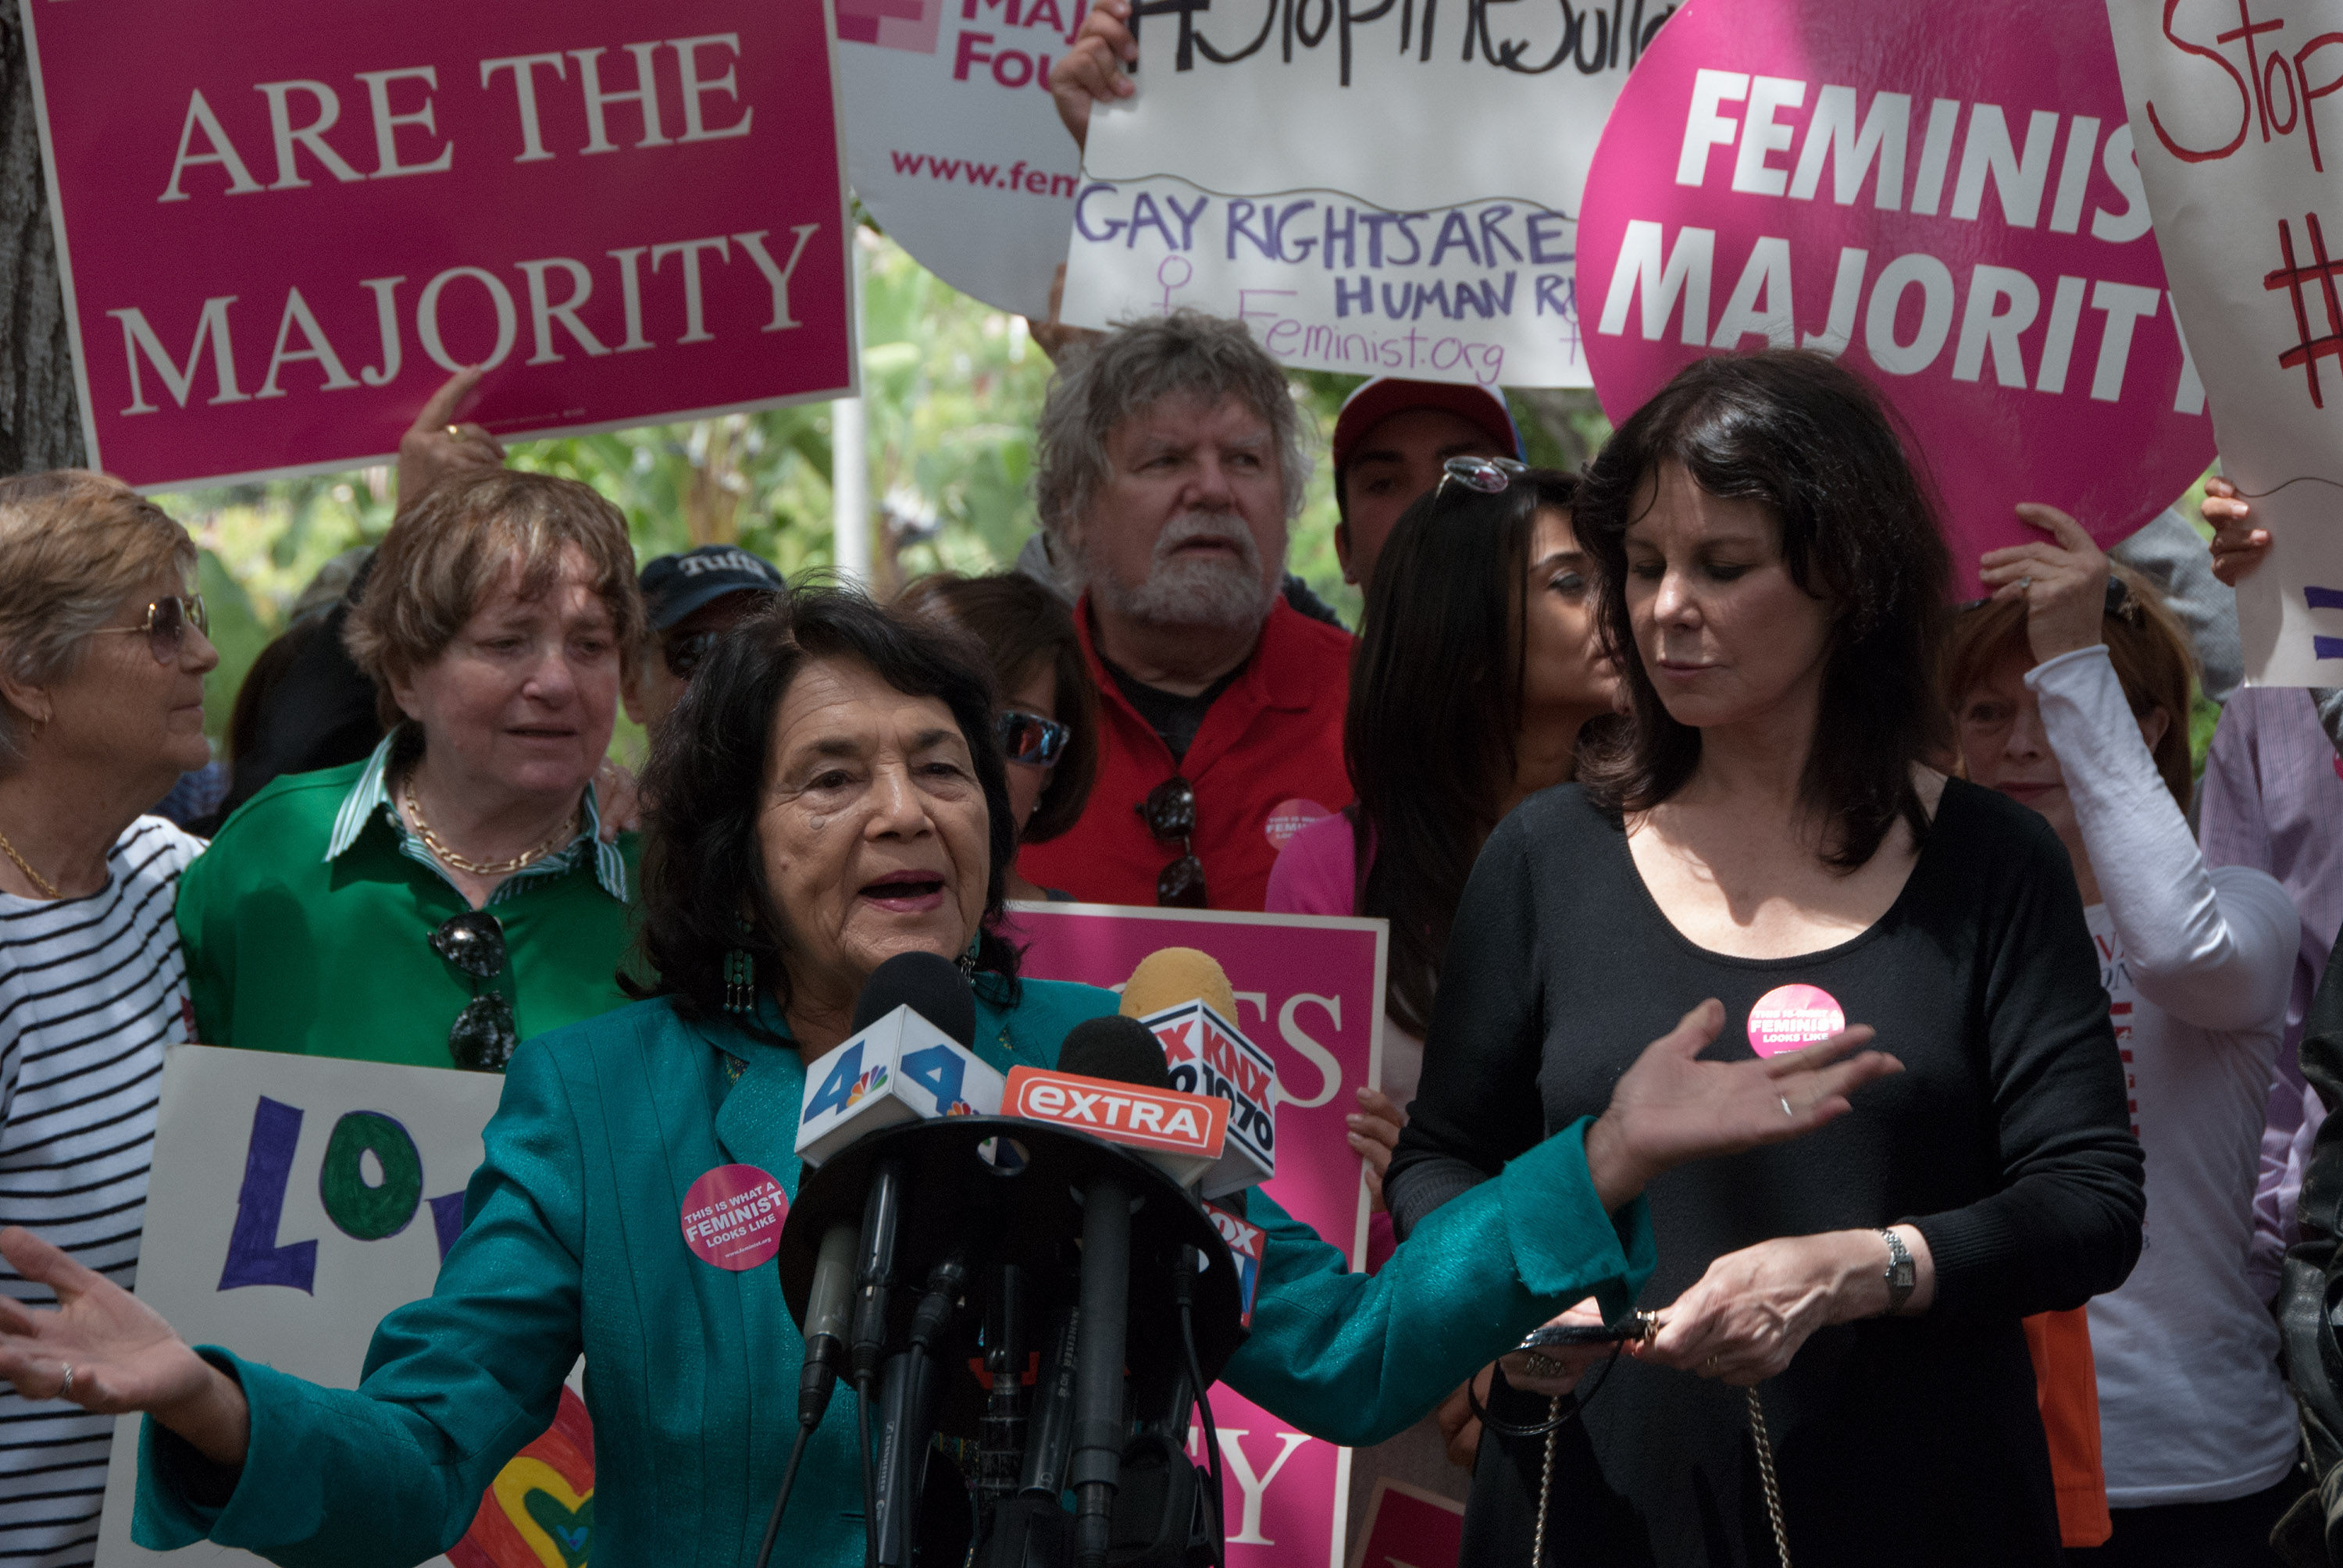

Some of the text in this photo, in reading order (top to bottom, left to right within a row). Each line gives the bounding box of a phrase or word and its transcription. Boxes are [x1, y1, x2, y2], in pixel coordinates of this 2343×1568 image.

[156, 32, 754, 203] ARE THE
[1674, 68, 2154, 244] FEMINIS
[1075, 182, 1209, 252] GAY
[106, 223, 821, 416] MAJORITY
[1335, 271, 1517, 321] HUMAN
[1750, 1017, 1840, 1033] FEMINIST
[1753, 1009, 1781, 1019] THIS
[1782, 1009, 1795, 1019] IS
[1830, 1009, 1840, 1018] A
[1763, 1032, 1830, 1044] LOOKS LIKE
[803, 1041, 866, 1124] 4
[900, 1043, 966, 1117] 4
[1202, 1020, 1273, 1117] KNX
[1202, 1062, 1274, 1153] 1070
[684, 1181, 775, 1224] THIS IS WHAT A
[686, 1190, 783, 1243] FEMINIST
[705, 1213, 777, 1249] LOOKS LIKE
[1202, 1203, 1259, 1256] OX
[725, 1238, 772, 1258] www.feminist.org
[1189, 1427, 1312, 1546] Y
